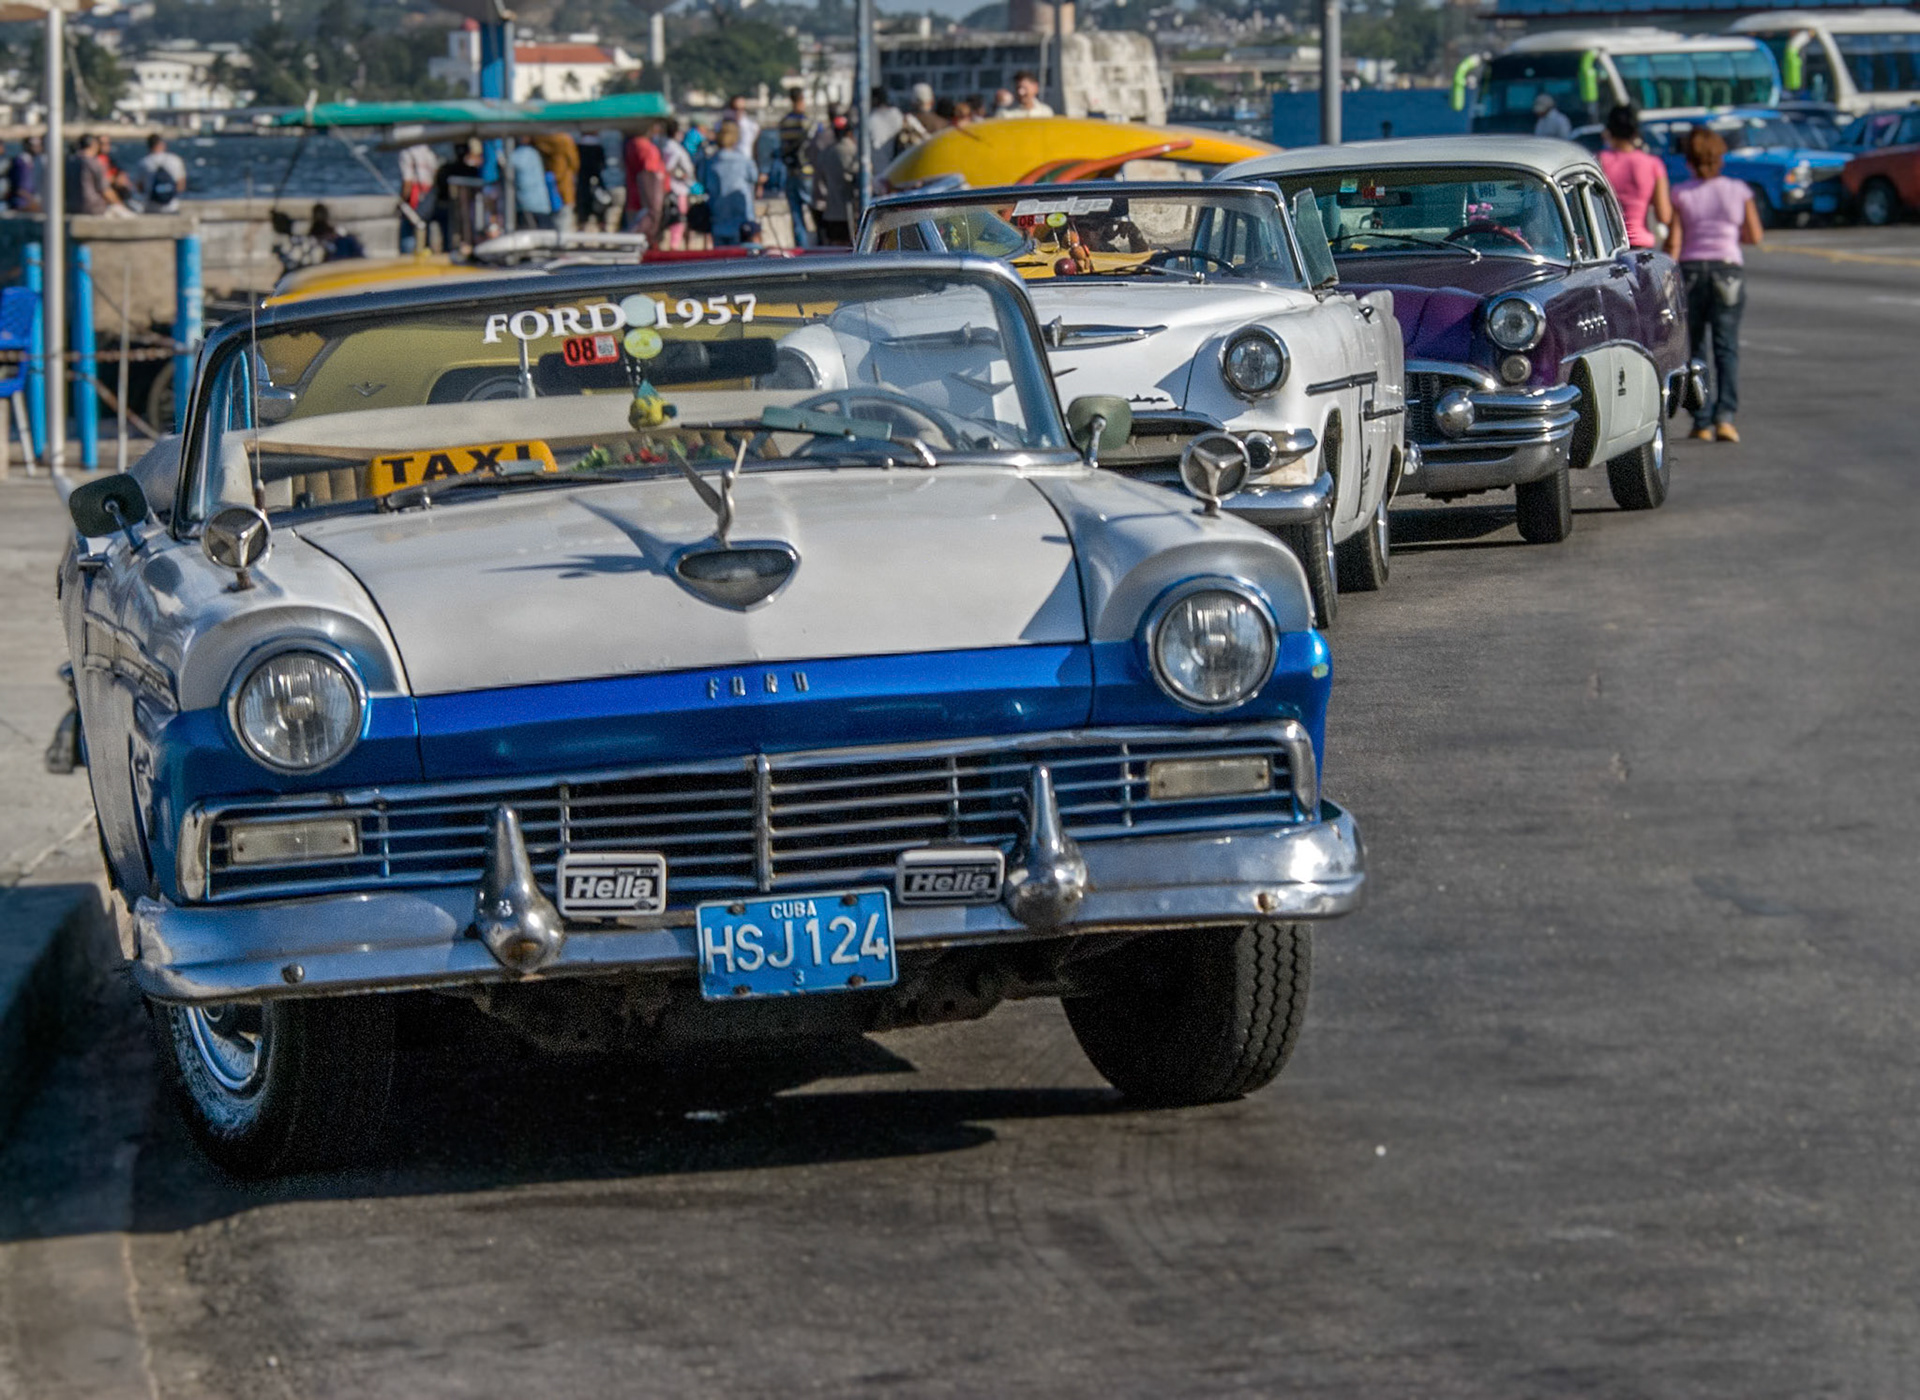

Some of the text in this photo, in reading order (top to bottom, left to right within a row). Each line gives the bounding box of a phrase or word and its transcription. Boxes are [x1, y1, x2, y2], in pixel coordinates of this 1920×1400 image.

[1012, 196, 1113, 216] Dodge
[482, 293, 757, 344] FORD 1957
[566, 338, 595, 362] 08
[381, 445, 532, 484] TAXI
[709, 671, 810, 699] FORD
[571, 875, 653, 899] Hella
[910, 872, 991, 892] Hella
[771, 900, 818, 919] CUBA
[703, 912, 890, 975] HSJ124
[794, 968, 805, 986] 3
